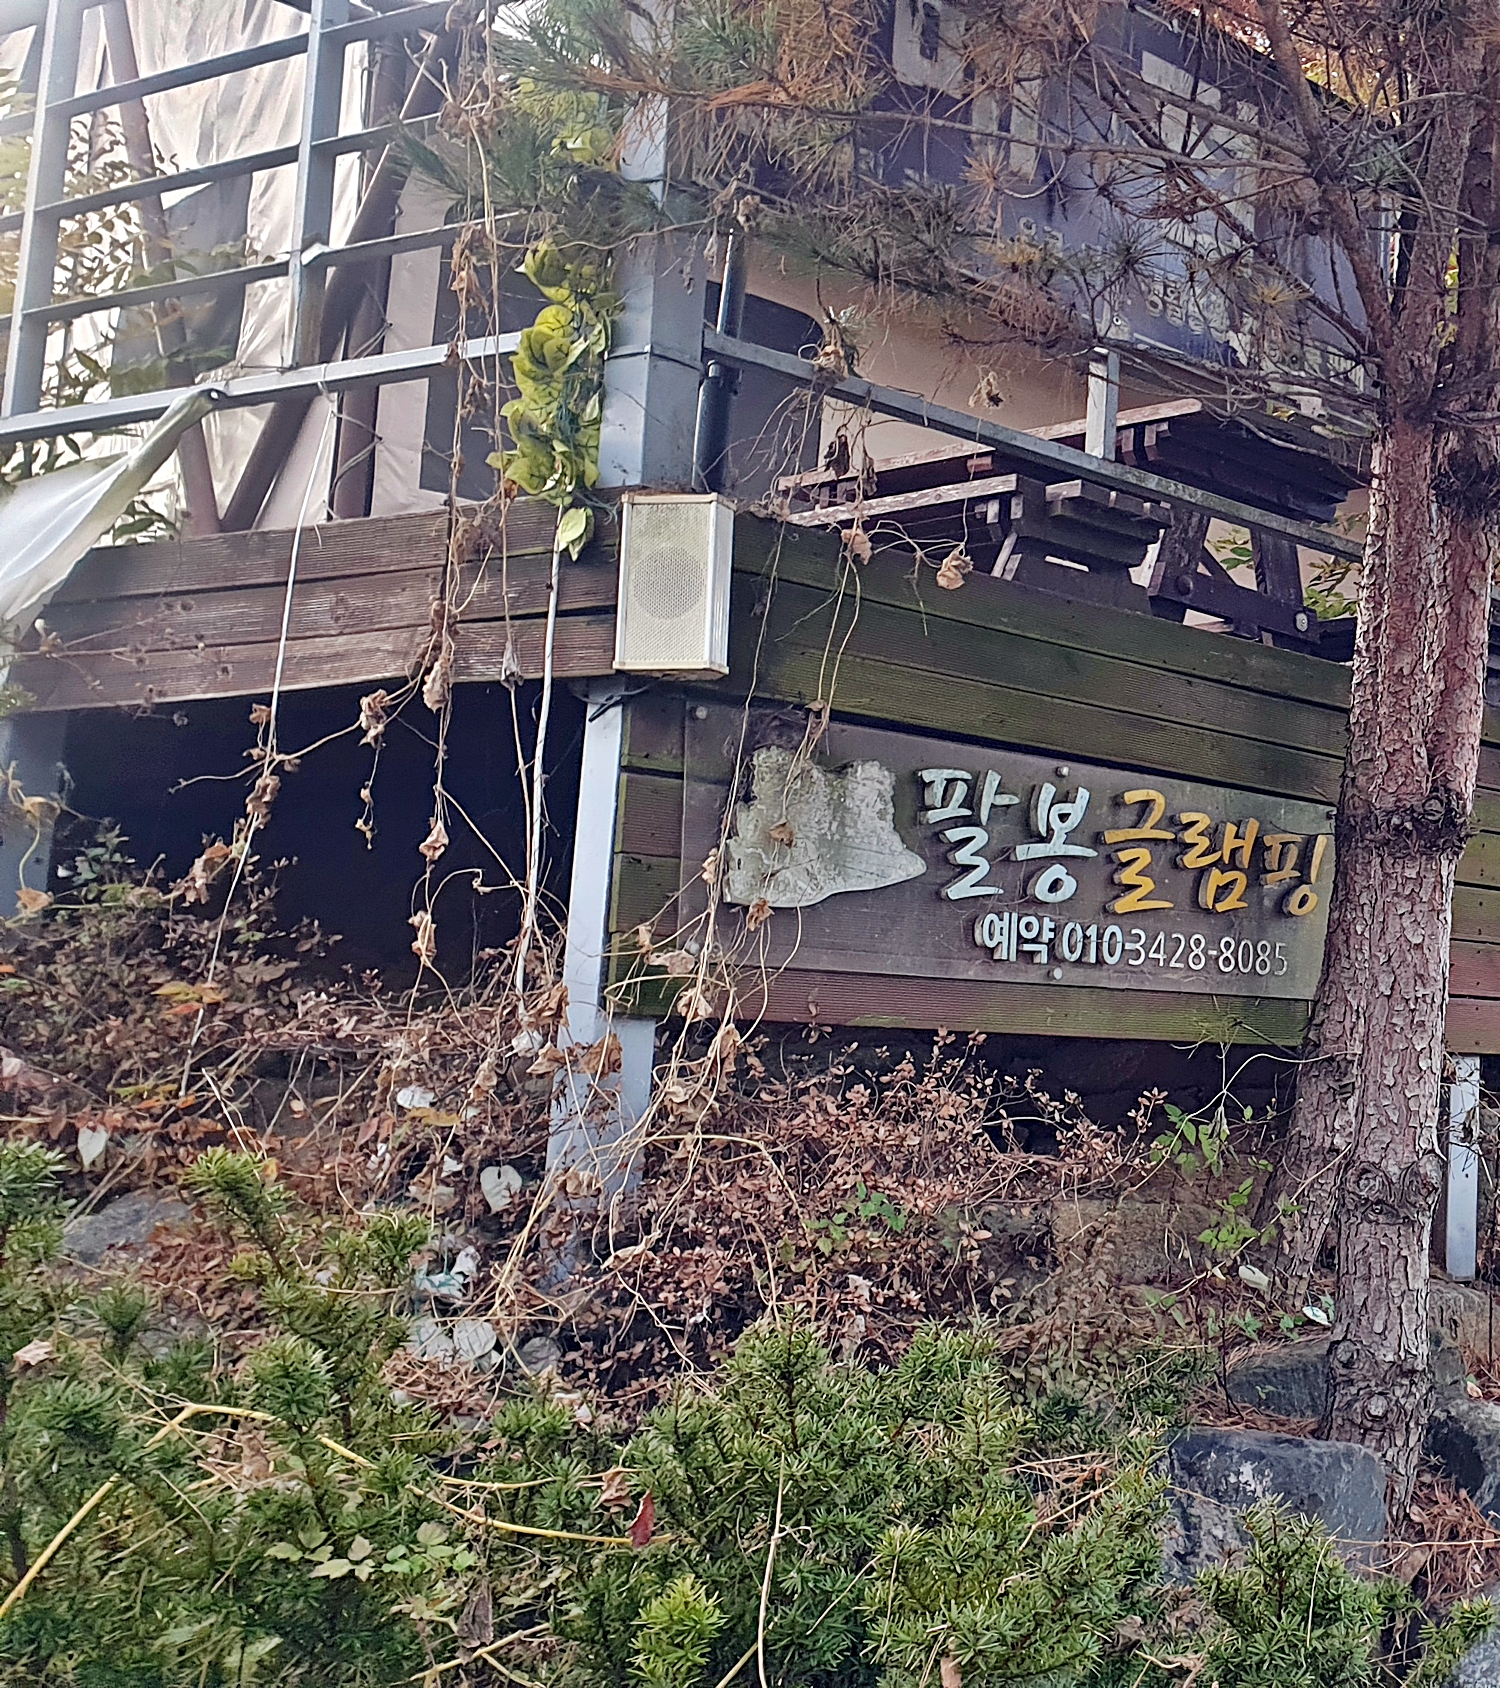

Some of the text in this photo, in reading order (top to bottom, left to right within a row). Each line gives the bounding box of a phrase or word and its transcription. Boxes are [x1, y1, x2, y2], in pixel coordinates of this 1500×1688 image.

[1104, 788, 1330, 917] 글램핑
[981, 911, 1289, 977] 예약 010-3428-8085
